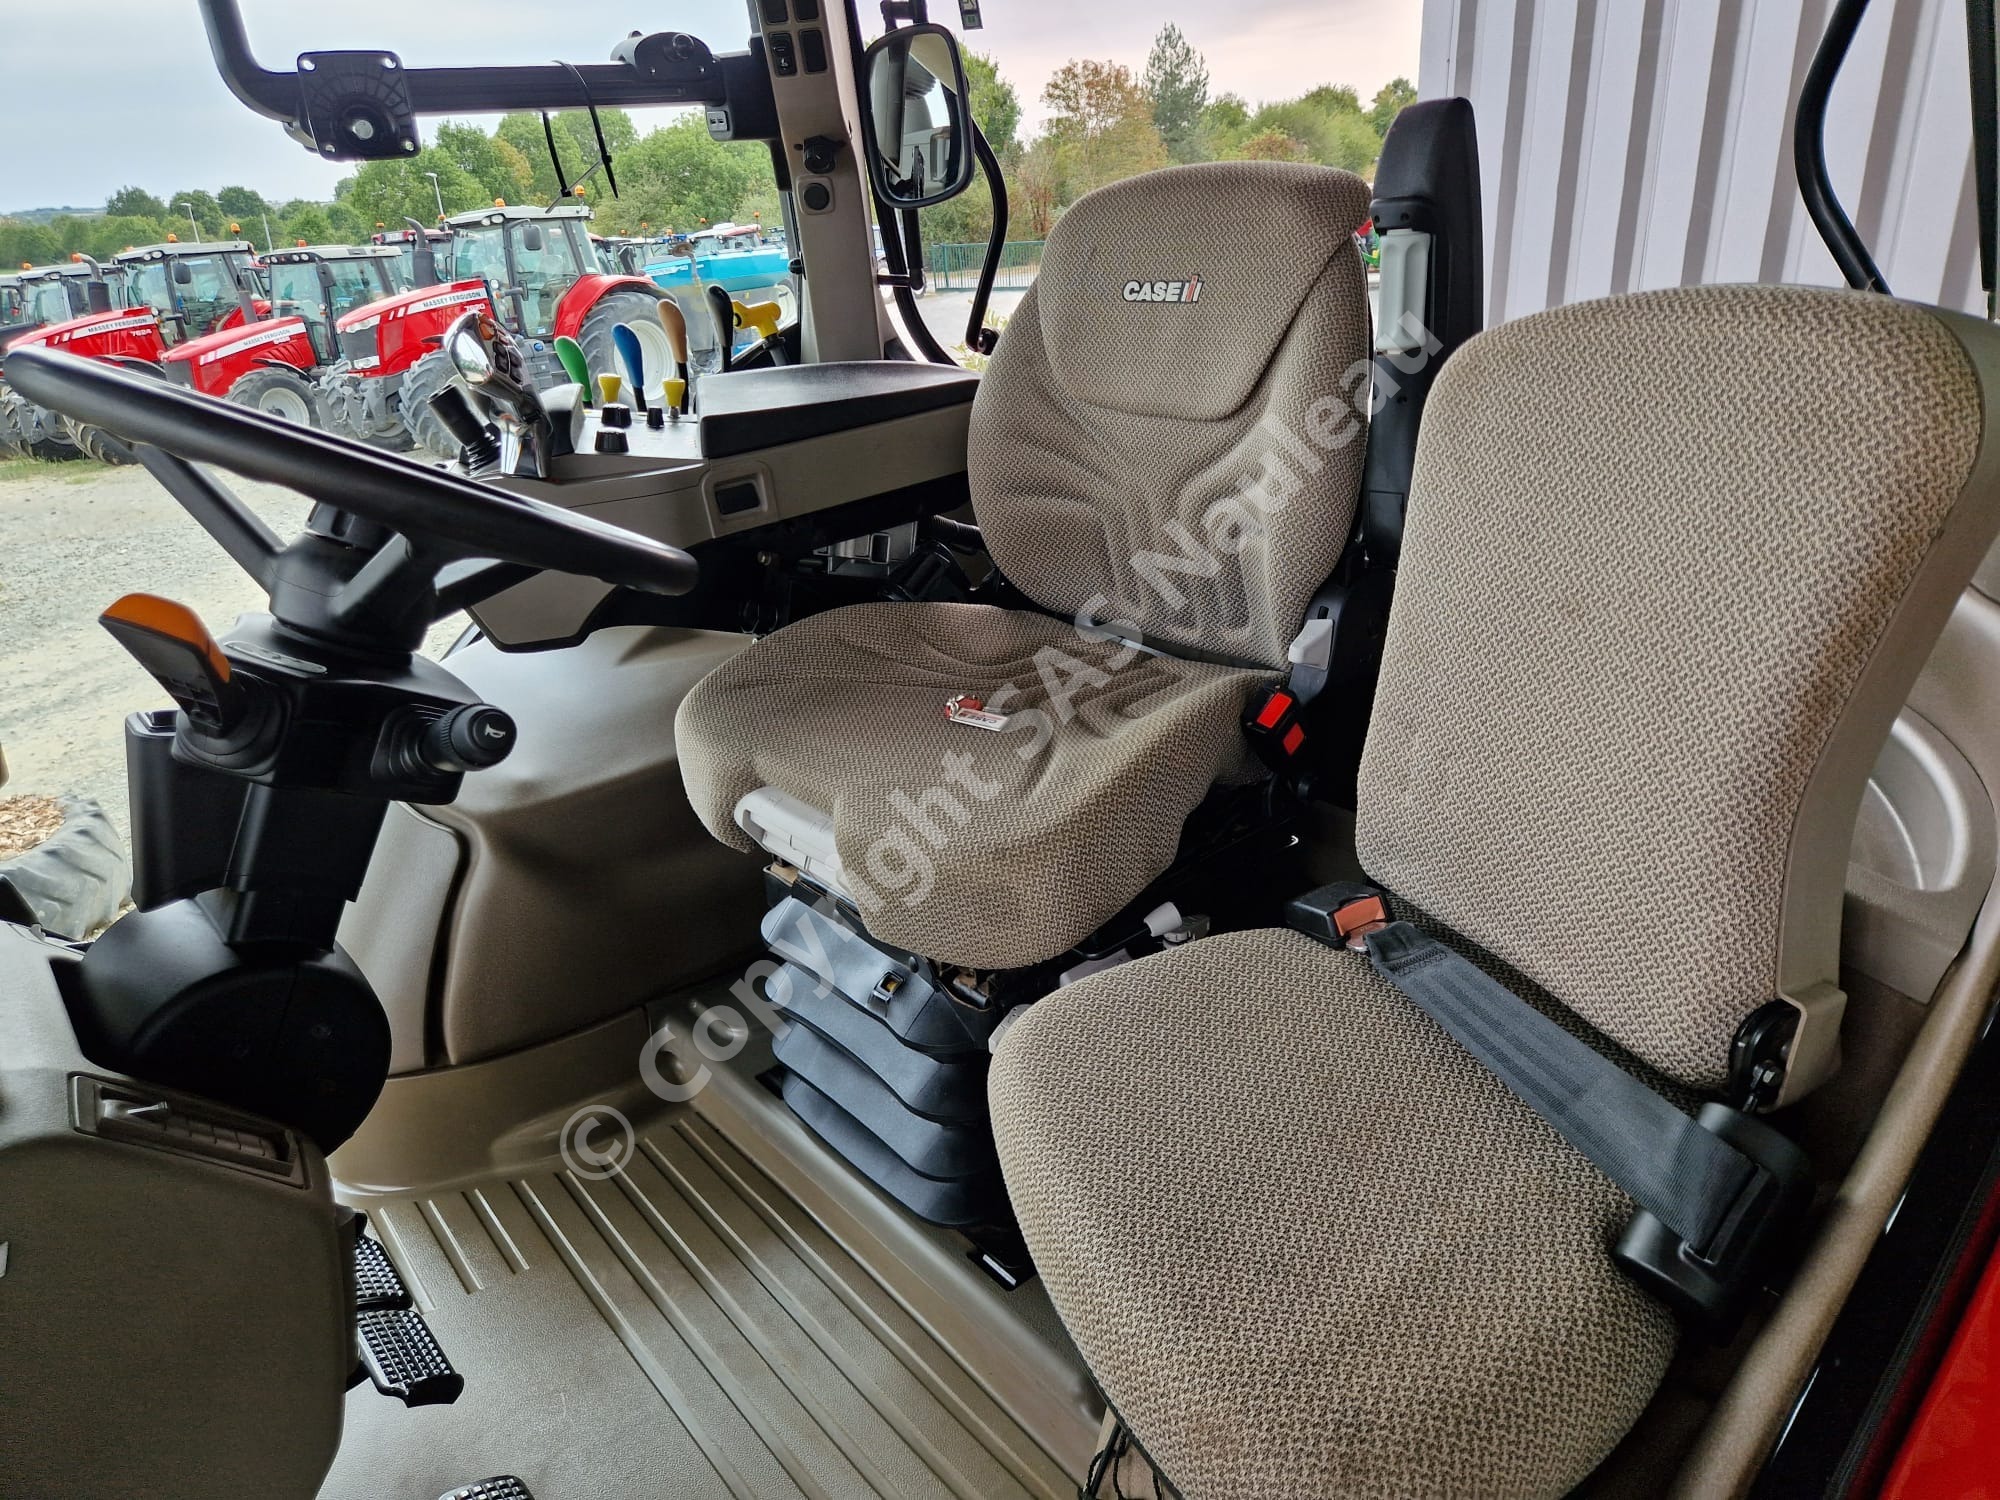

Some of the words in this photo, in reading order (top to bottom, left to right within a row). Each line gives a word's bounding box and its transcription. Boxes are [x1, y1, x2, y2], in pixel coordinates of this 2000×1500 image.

[423, 298, 448, 307] MASSEY
[449, 291, 481, 302] FERGUSON
[87, 323, 114, 333] MASSEY
[115, 317, 148, 327] FERGUSON
